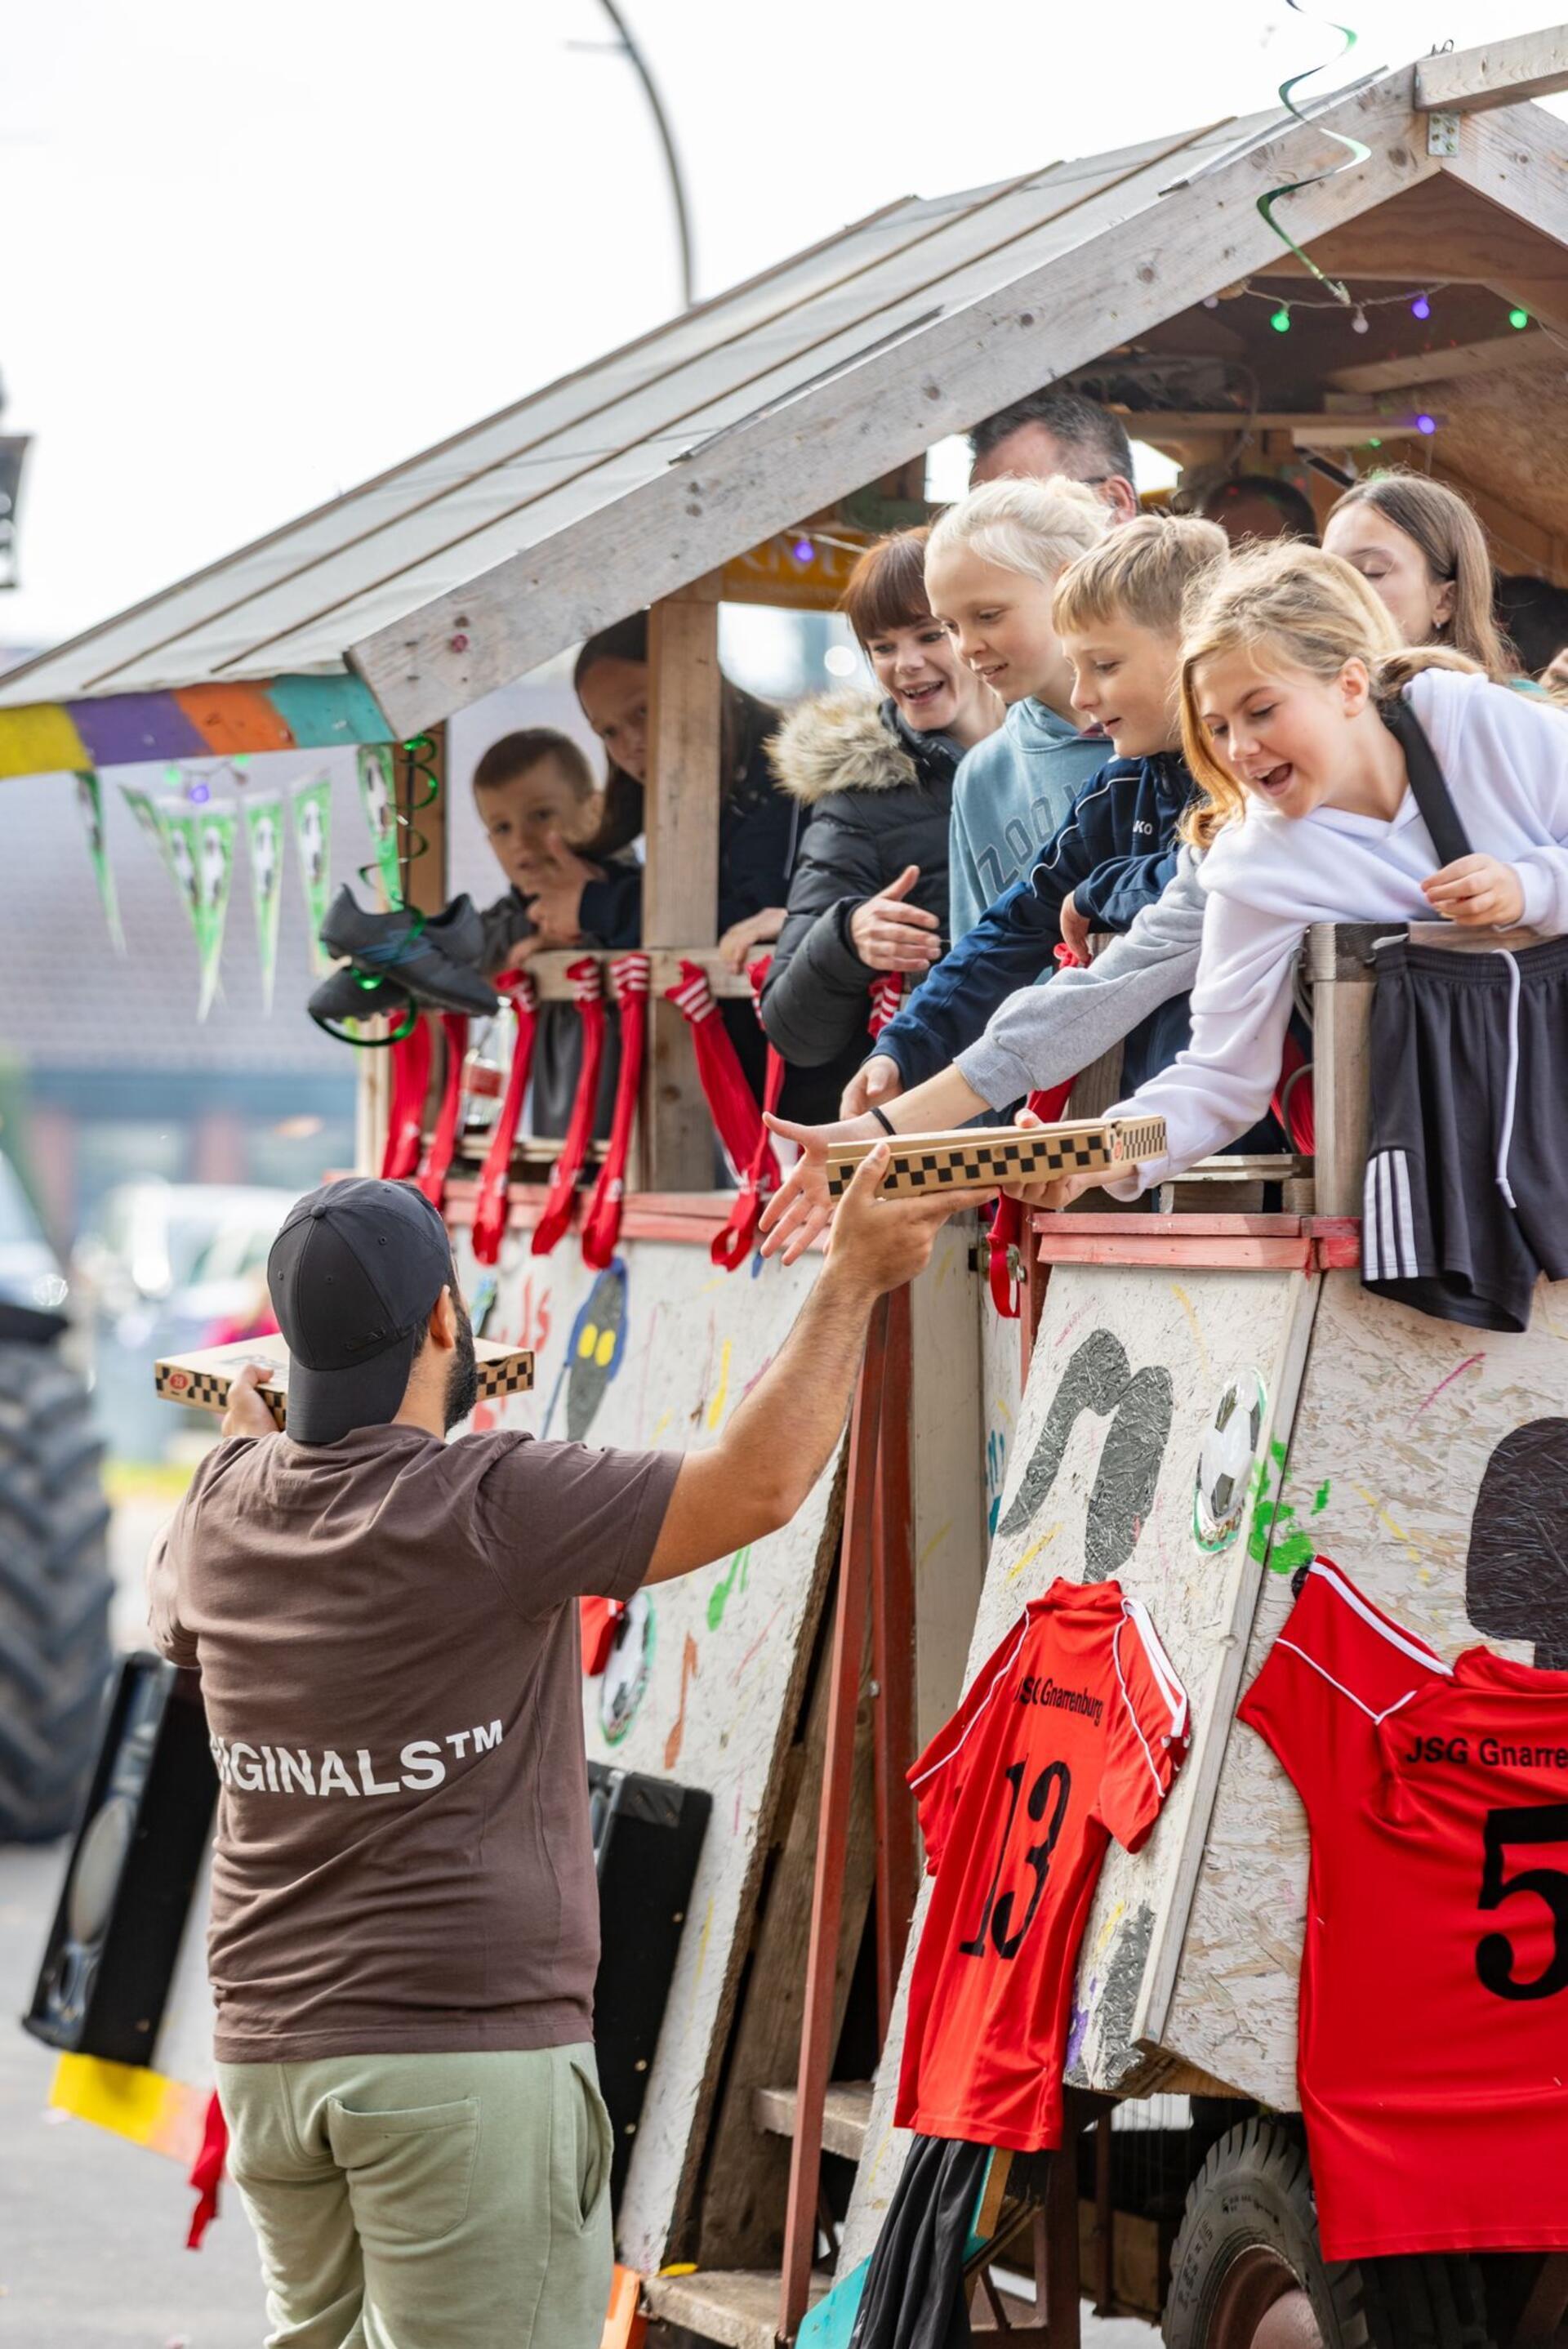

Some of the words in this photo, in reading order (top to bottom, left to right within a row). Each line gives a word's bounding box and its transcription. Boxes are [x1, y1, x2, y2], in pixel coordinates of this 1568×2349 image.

[1132, 820, 1153, 836] KO
[1040, 1678, 1104, 1727] Gnarrenburg
[1407, 1736, 1468, 1765] JSG
[959, 1754, 1071, 1960] 13
[1475, 1803, 1568, 2001] 5
